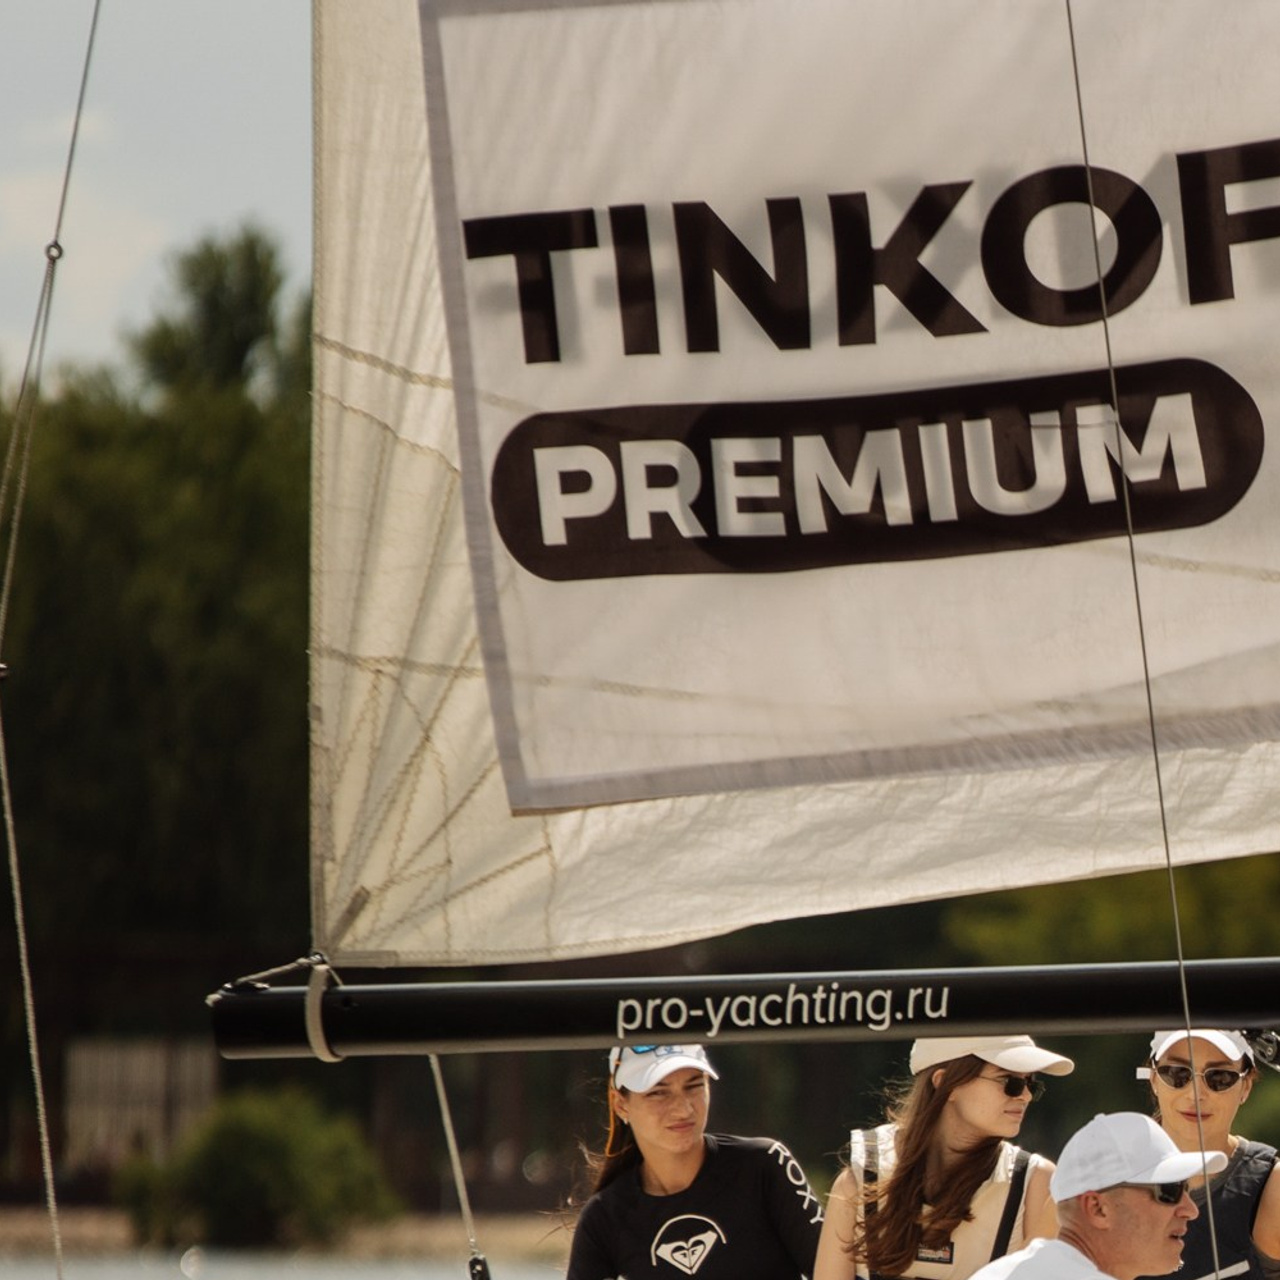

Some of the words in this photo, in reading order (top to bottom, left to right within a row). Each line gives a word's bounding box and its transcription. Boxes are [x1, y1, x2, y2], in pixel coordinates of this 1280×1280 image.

[533, 392, 1207, 546] PREMIUM
[616, 982, 950, 1038] pro-yachting.ru
[767, 1142, 825, 1224] ROXY
